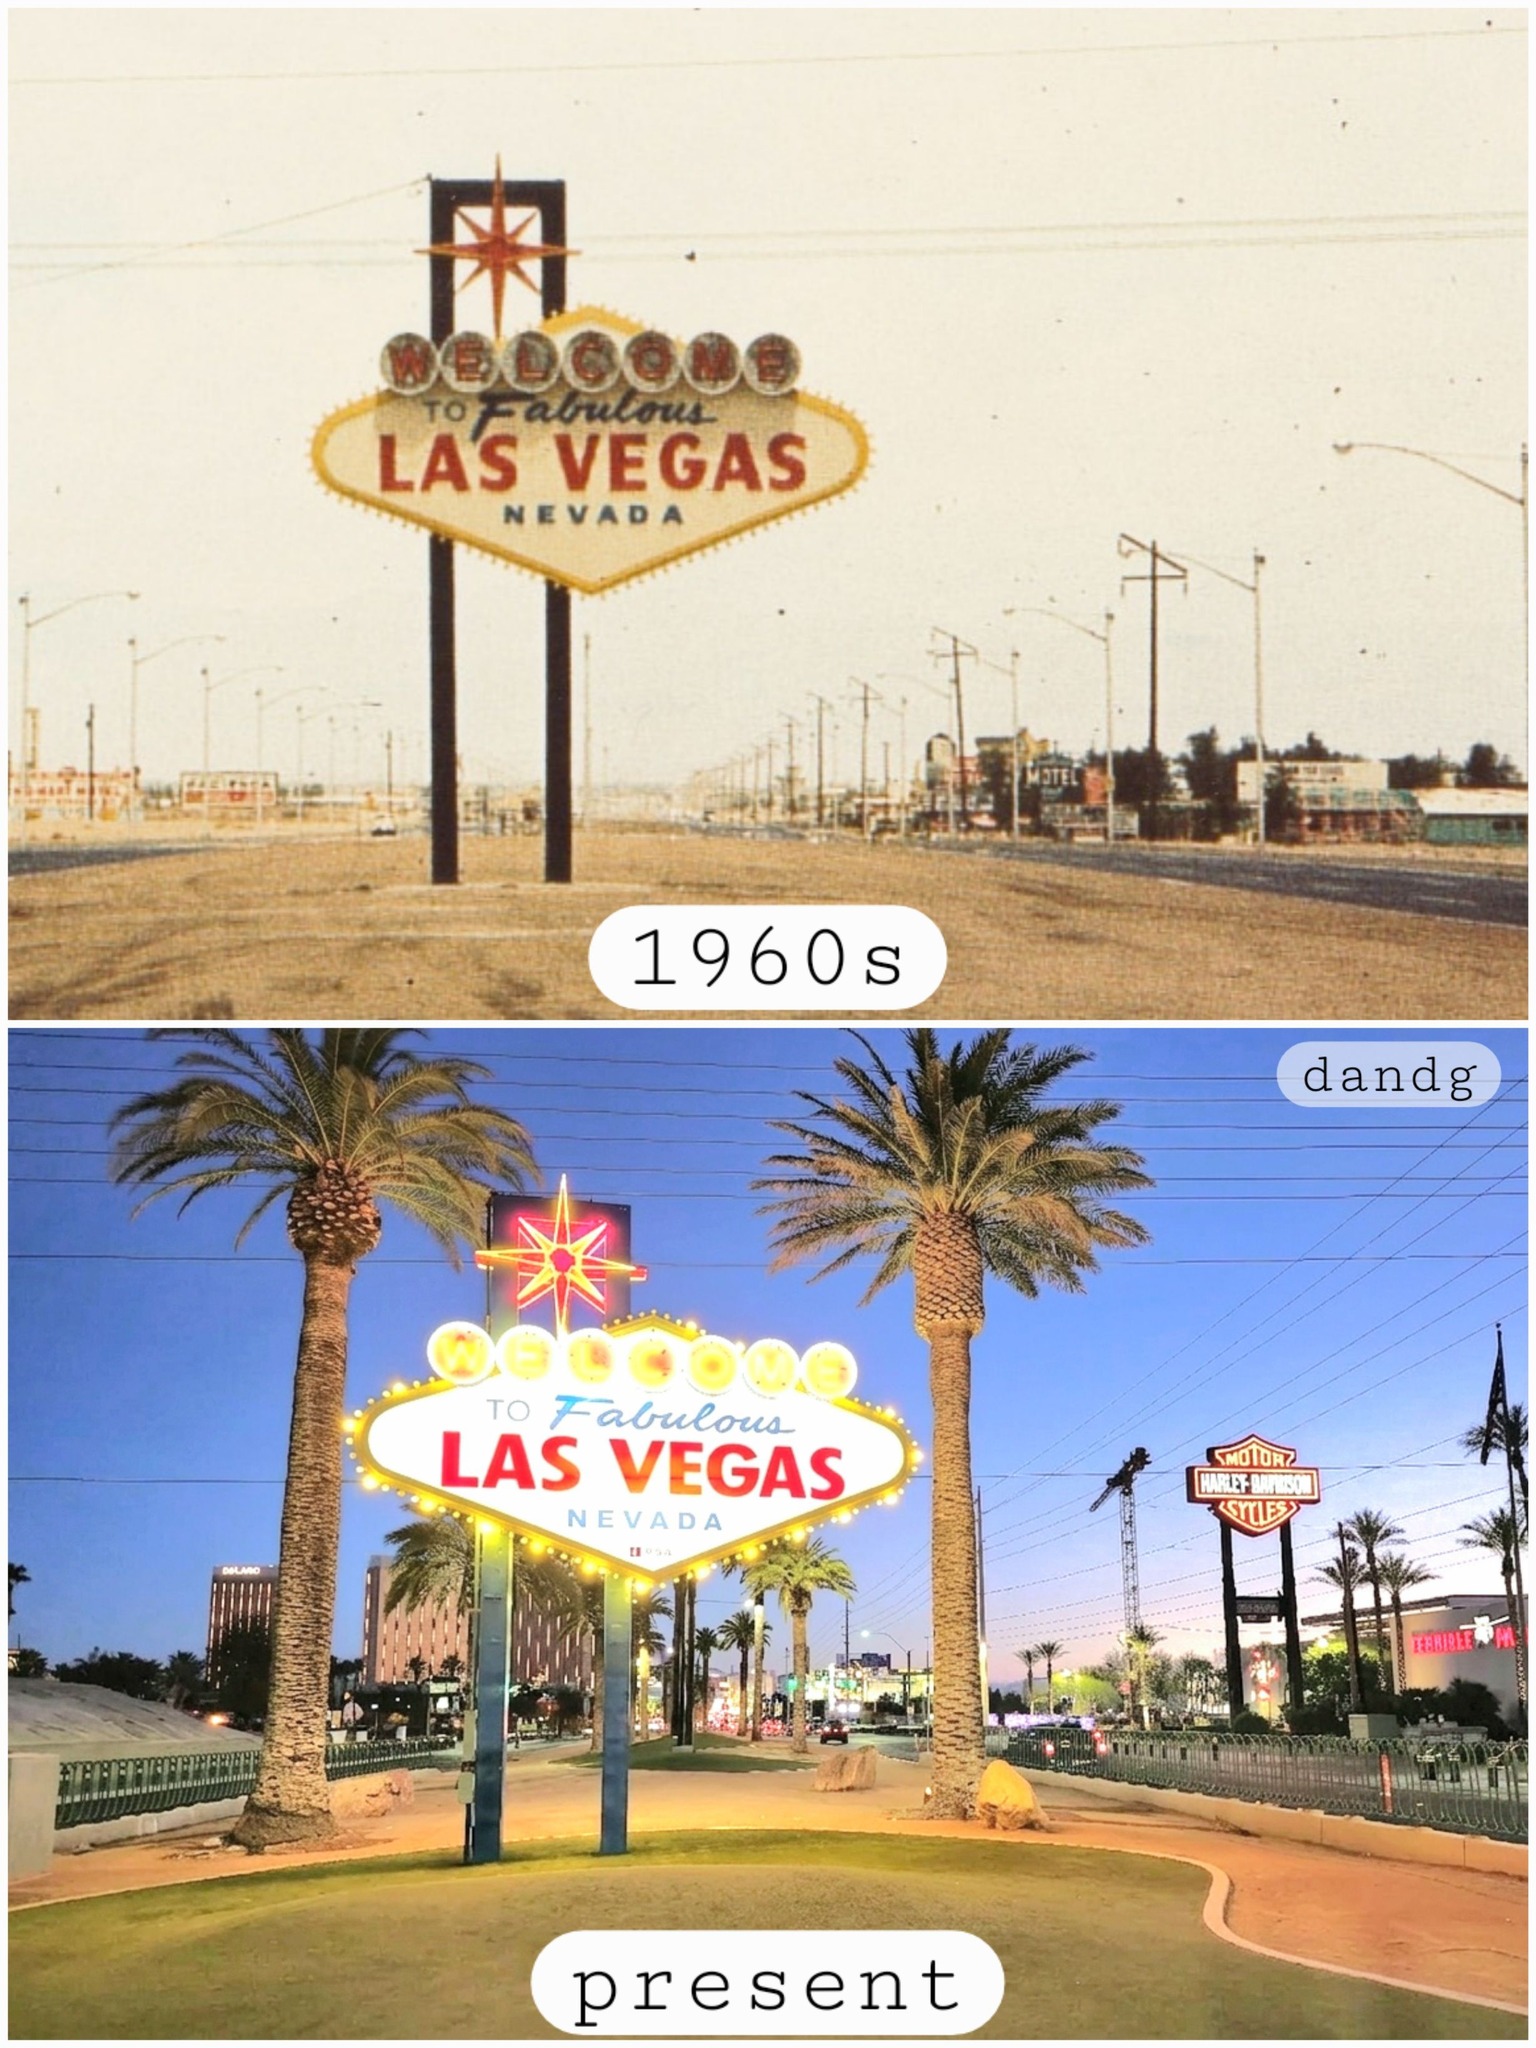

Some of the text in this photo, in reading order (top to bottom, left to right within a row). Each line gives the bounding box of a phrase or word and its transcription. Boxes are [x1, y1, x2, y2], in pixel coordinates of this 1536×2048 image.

[386, 338, 790, 386] WELCOME
[423, 391, 718, 443] TO Fabulous
[379, 433, 808, 493] LAS VEGAS
[503, 505, 684, 525] NEVADA
[1025, 767, 1080, 787] MOTEL
[434, 1328, 850, 1394] WELCOME
[486, 1394, 796, 1435] TO Fabulous
[440, 1431, 846, 1500] LAS VEGAS
[1224, 1443, 1286, 1467] MOTOR
[568, 1509, 723, 1532] NEVADA
[1226, 1500, 1288, 1526] CYCLES
